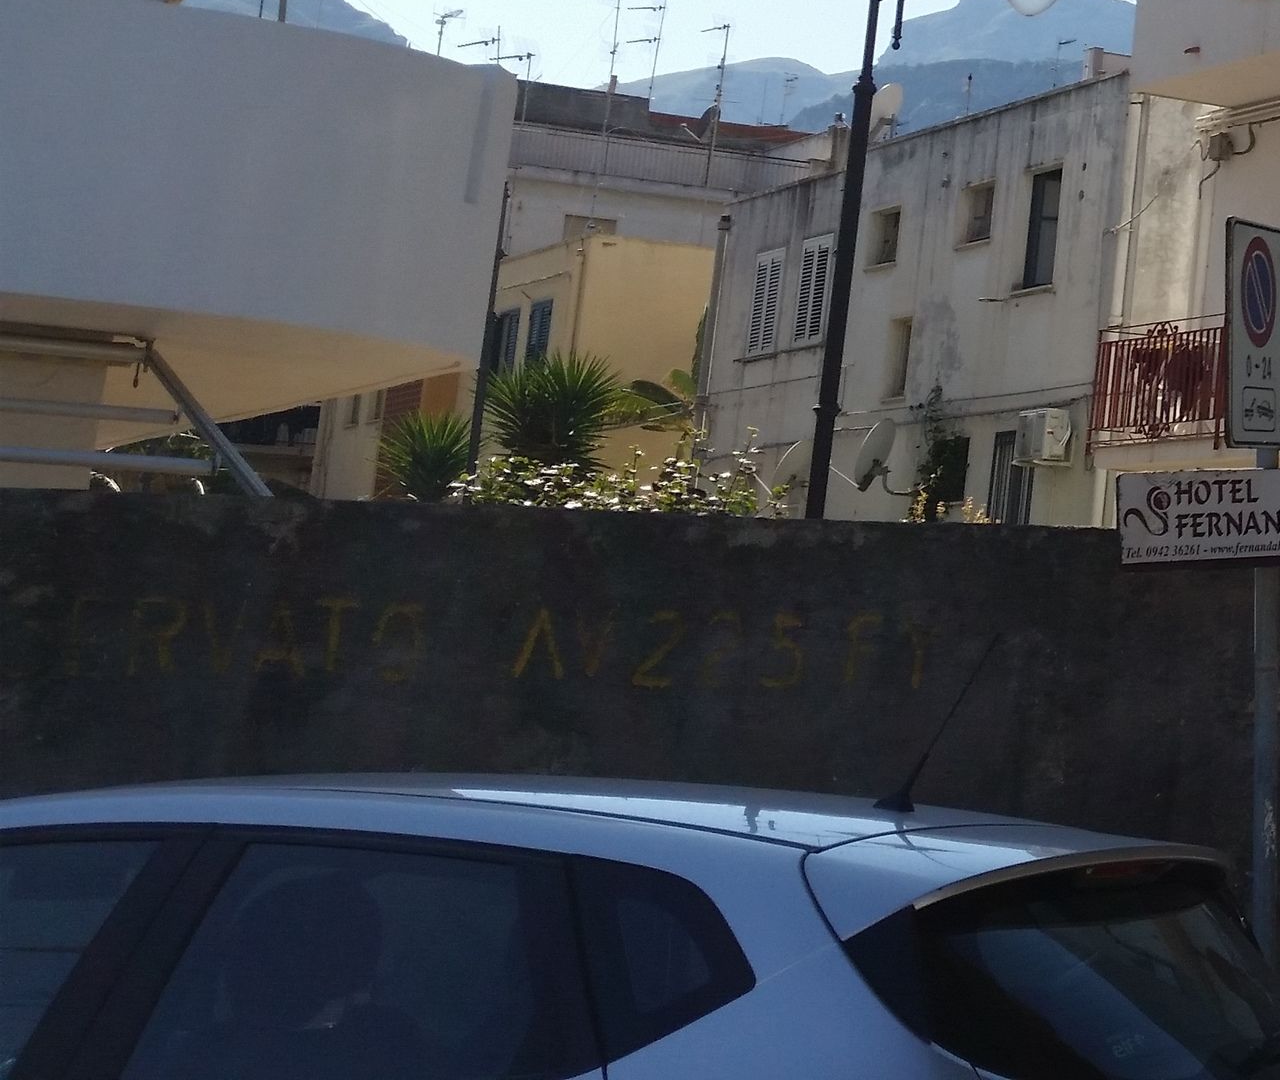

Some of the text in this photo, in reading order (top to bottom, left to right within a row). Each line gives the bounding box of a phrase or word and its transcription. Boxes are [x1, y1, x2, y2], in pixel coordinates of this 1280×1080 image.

[1174, 479, 1259, 506] HOTEL
[1125, 547, 1143, 559] Tel.
[1145, 545, 1170, 558] 0942
[1172, 544, 1200, 557] 36261
